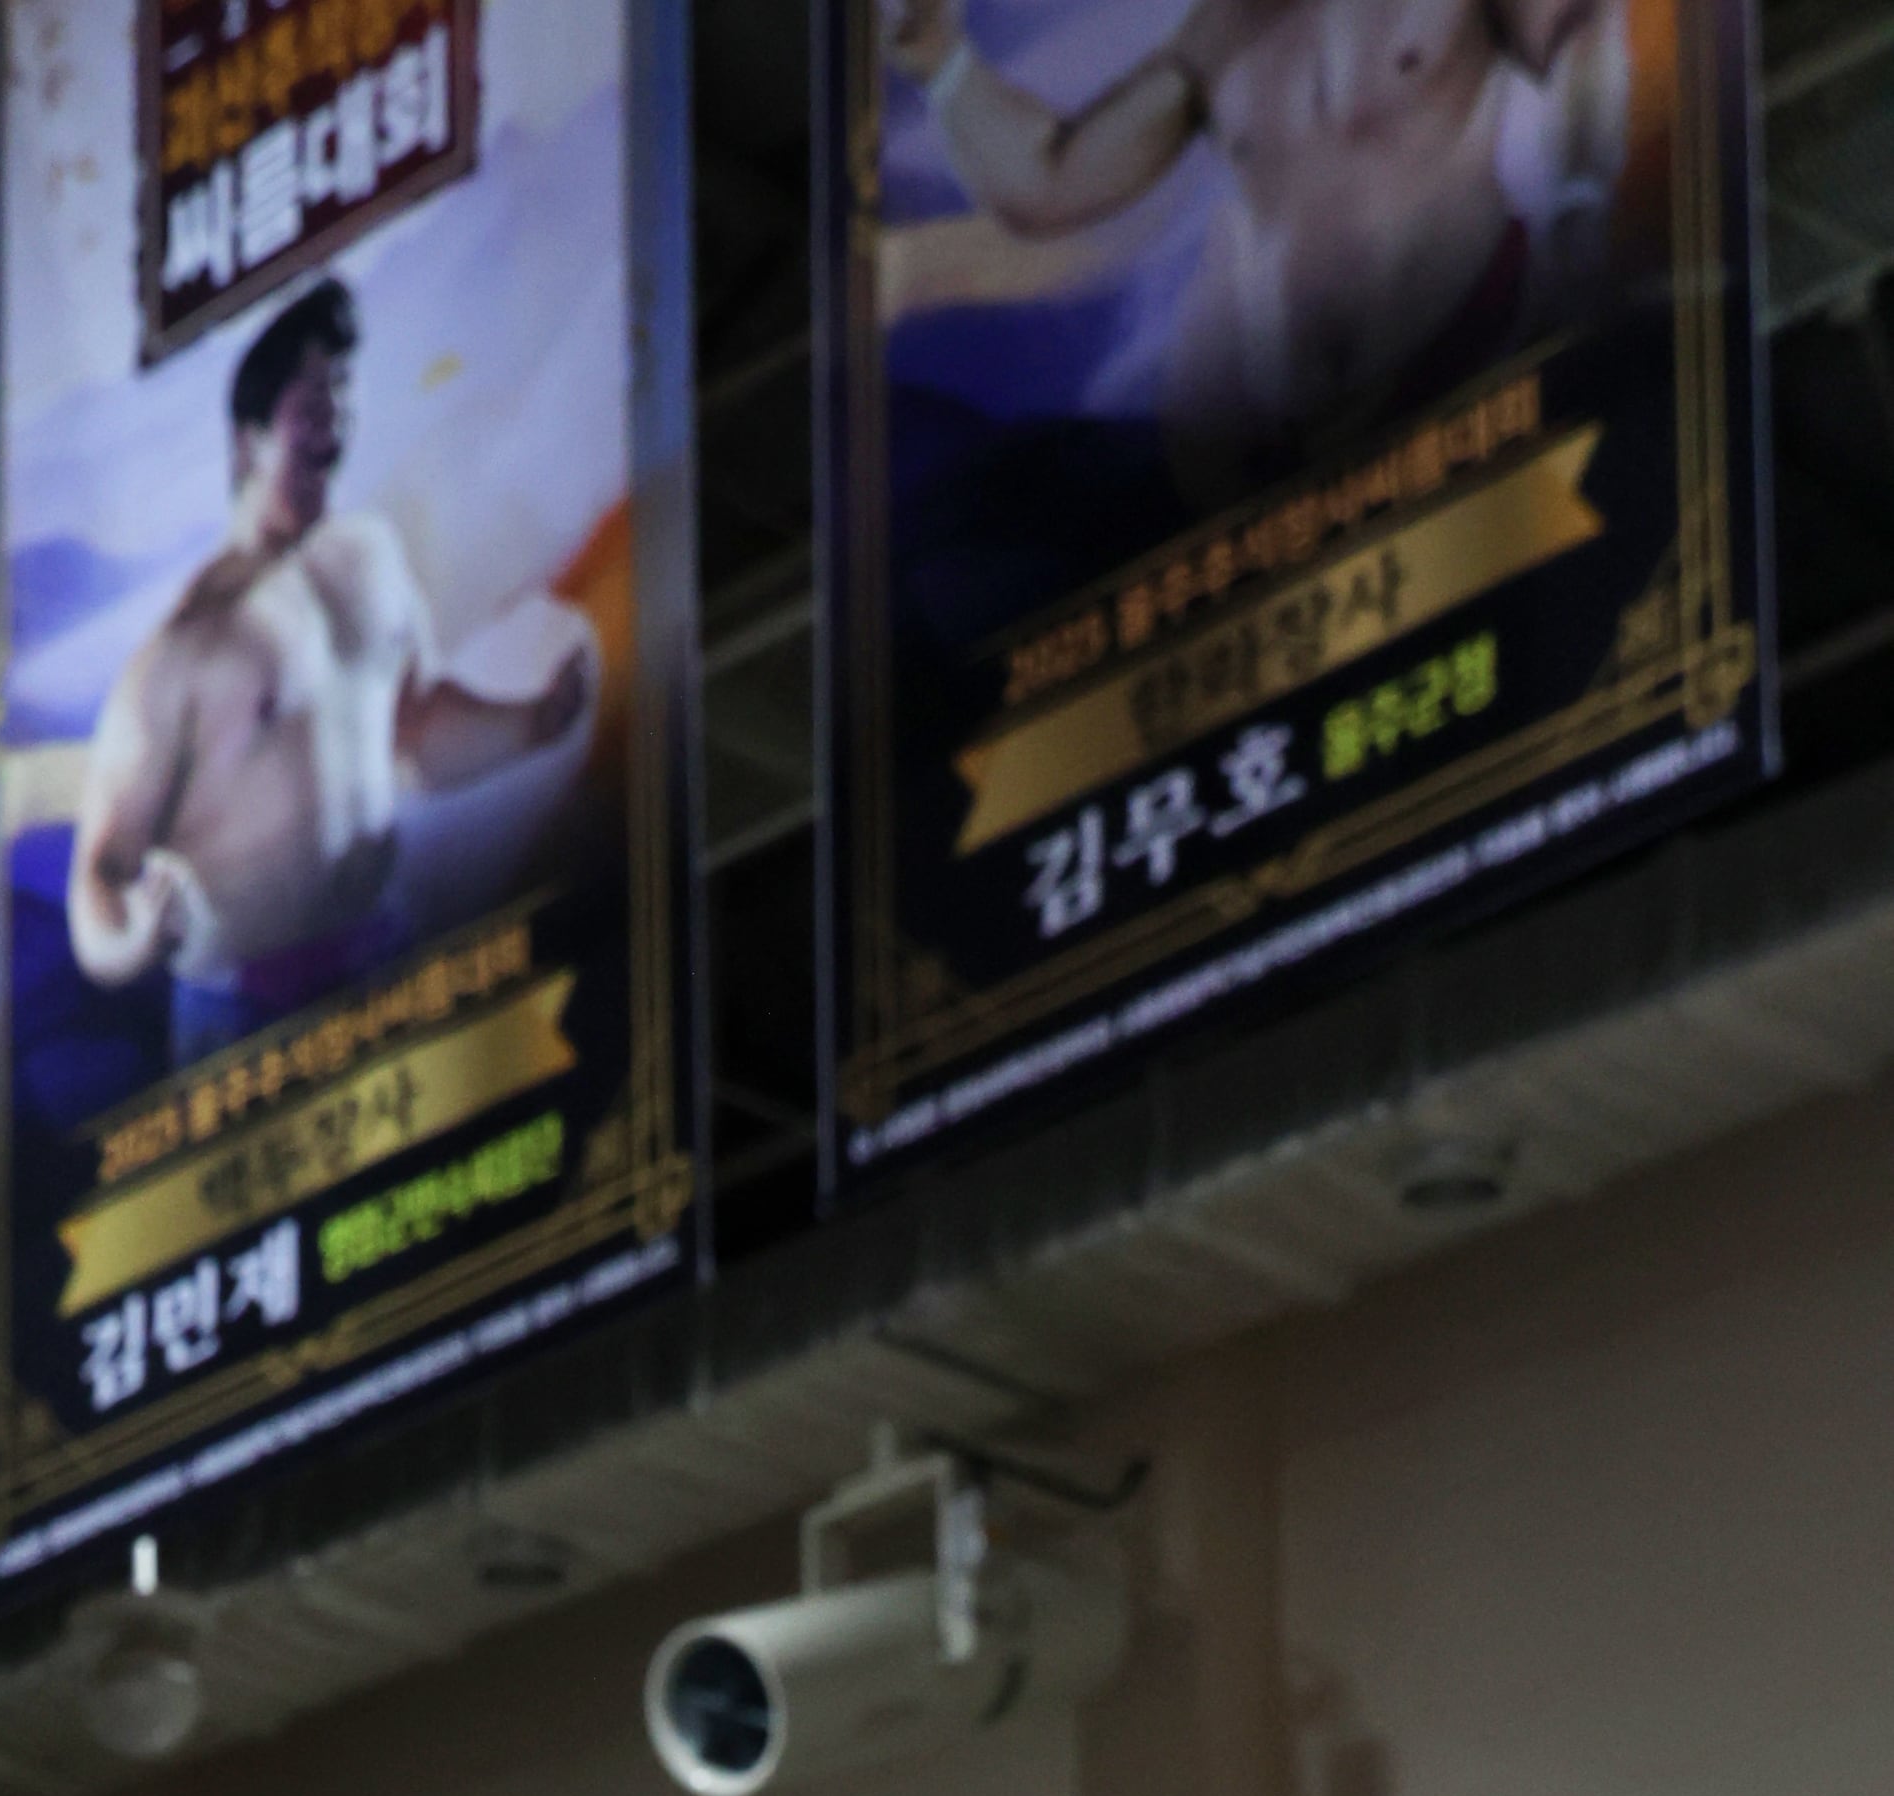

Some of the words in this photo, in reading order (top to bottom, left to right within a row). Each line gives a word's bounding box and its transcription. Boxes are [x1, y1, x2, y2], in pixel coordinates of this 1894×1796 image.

[163, 23, 450, 291] 씨름대회
[1021, 721, 1308, 940] 김무호
[79, 1217, 302, 1413] 김민재
